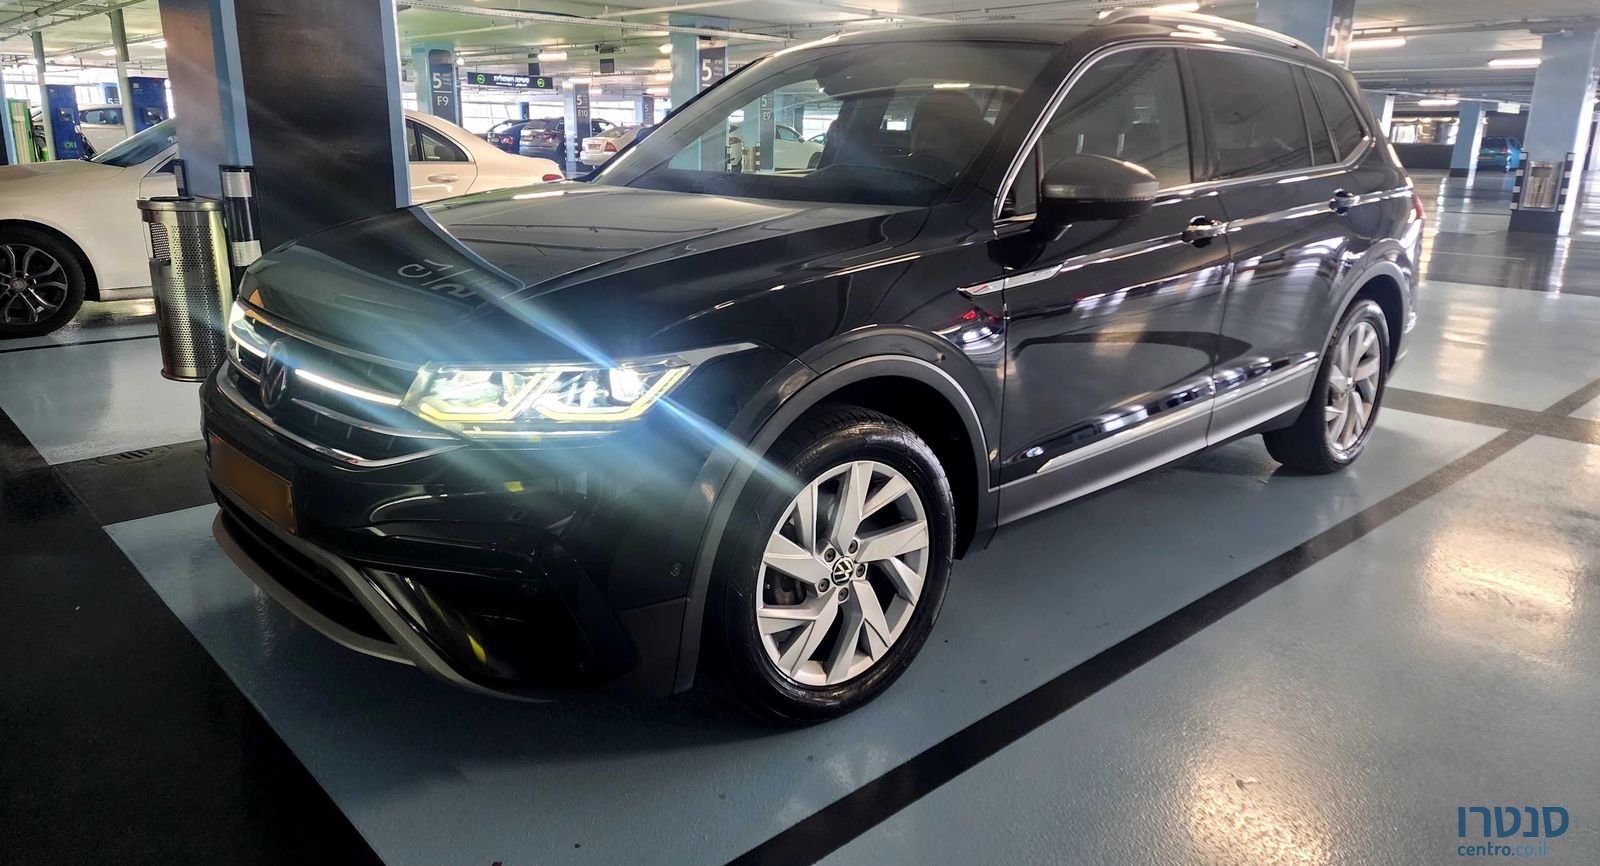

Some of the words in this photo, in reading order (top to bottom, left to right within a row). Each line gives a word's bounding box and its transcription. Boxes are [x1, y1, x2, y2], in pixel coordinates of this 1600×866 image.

[1327, 16, 1340, 53] 5
[702, 59, 713, 81] 5
[433, 72, 442, 89] 5
[437, 95, 449, 106] F9
[577, 95, 583, 105] 5
[762, 95, 767, 107] 5
